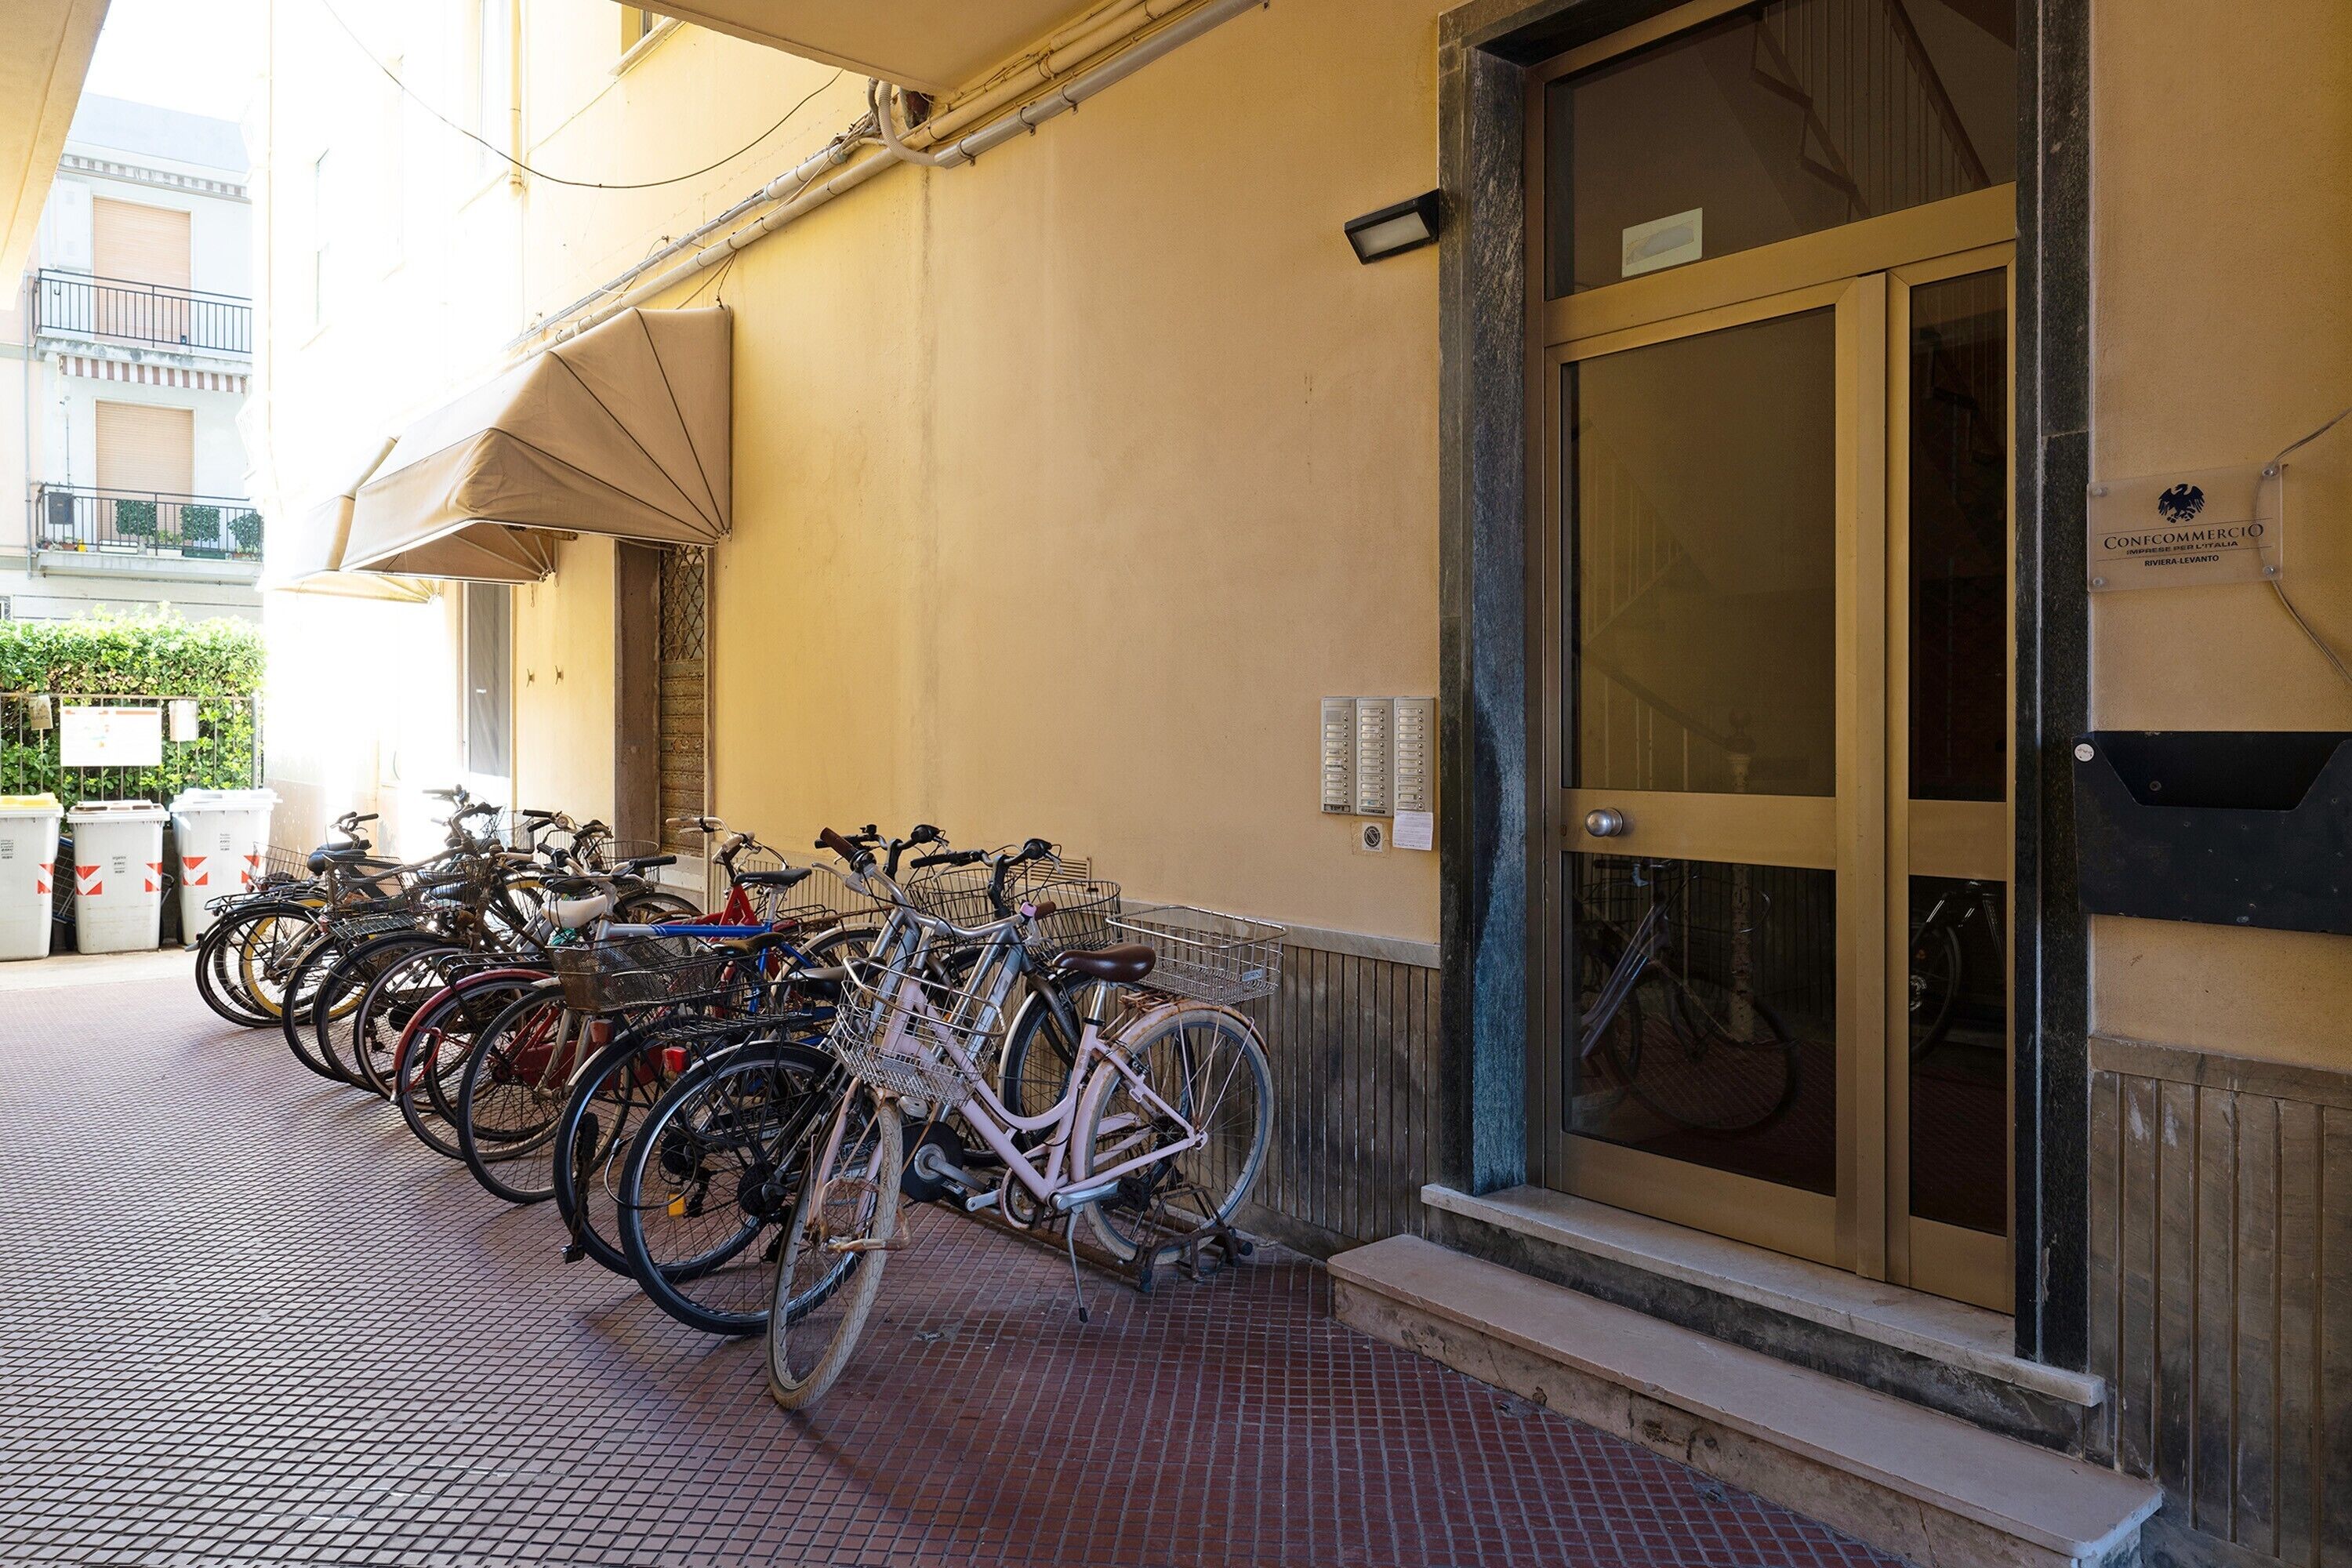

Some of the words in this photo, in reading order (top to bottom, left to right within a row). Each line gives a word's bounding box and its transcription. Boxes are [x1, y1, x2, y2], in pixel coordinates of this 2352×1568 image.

[2103, 523, 2264, 550] CONFCOMMERCIO
[2126, 546, 2172, 555] IMPRESE
[2196, 540, 2238, 550] L'ITALIA
[2144, 554, 2220, 567] RIVIERA-LEVANTO
